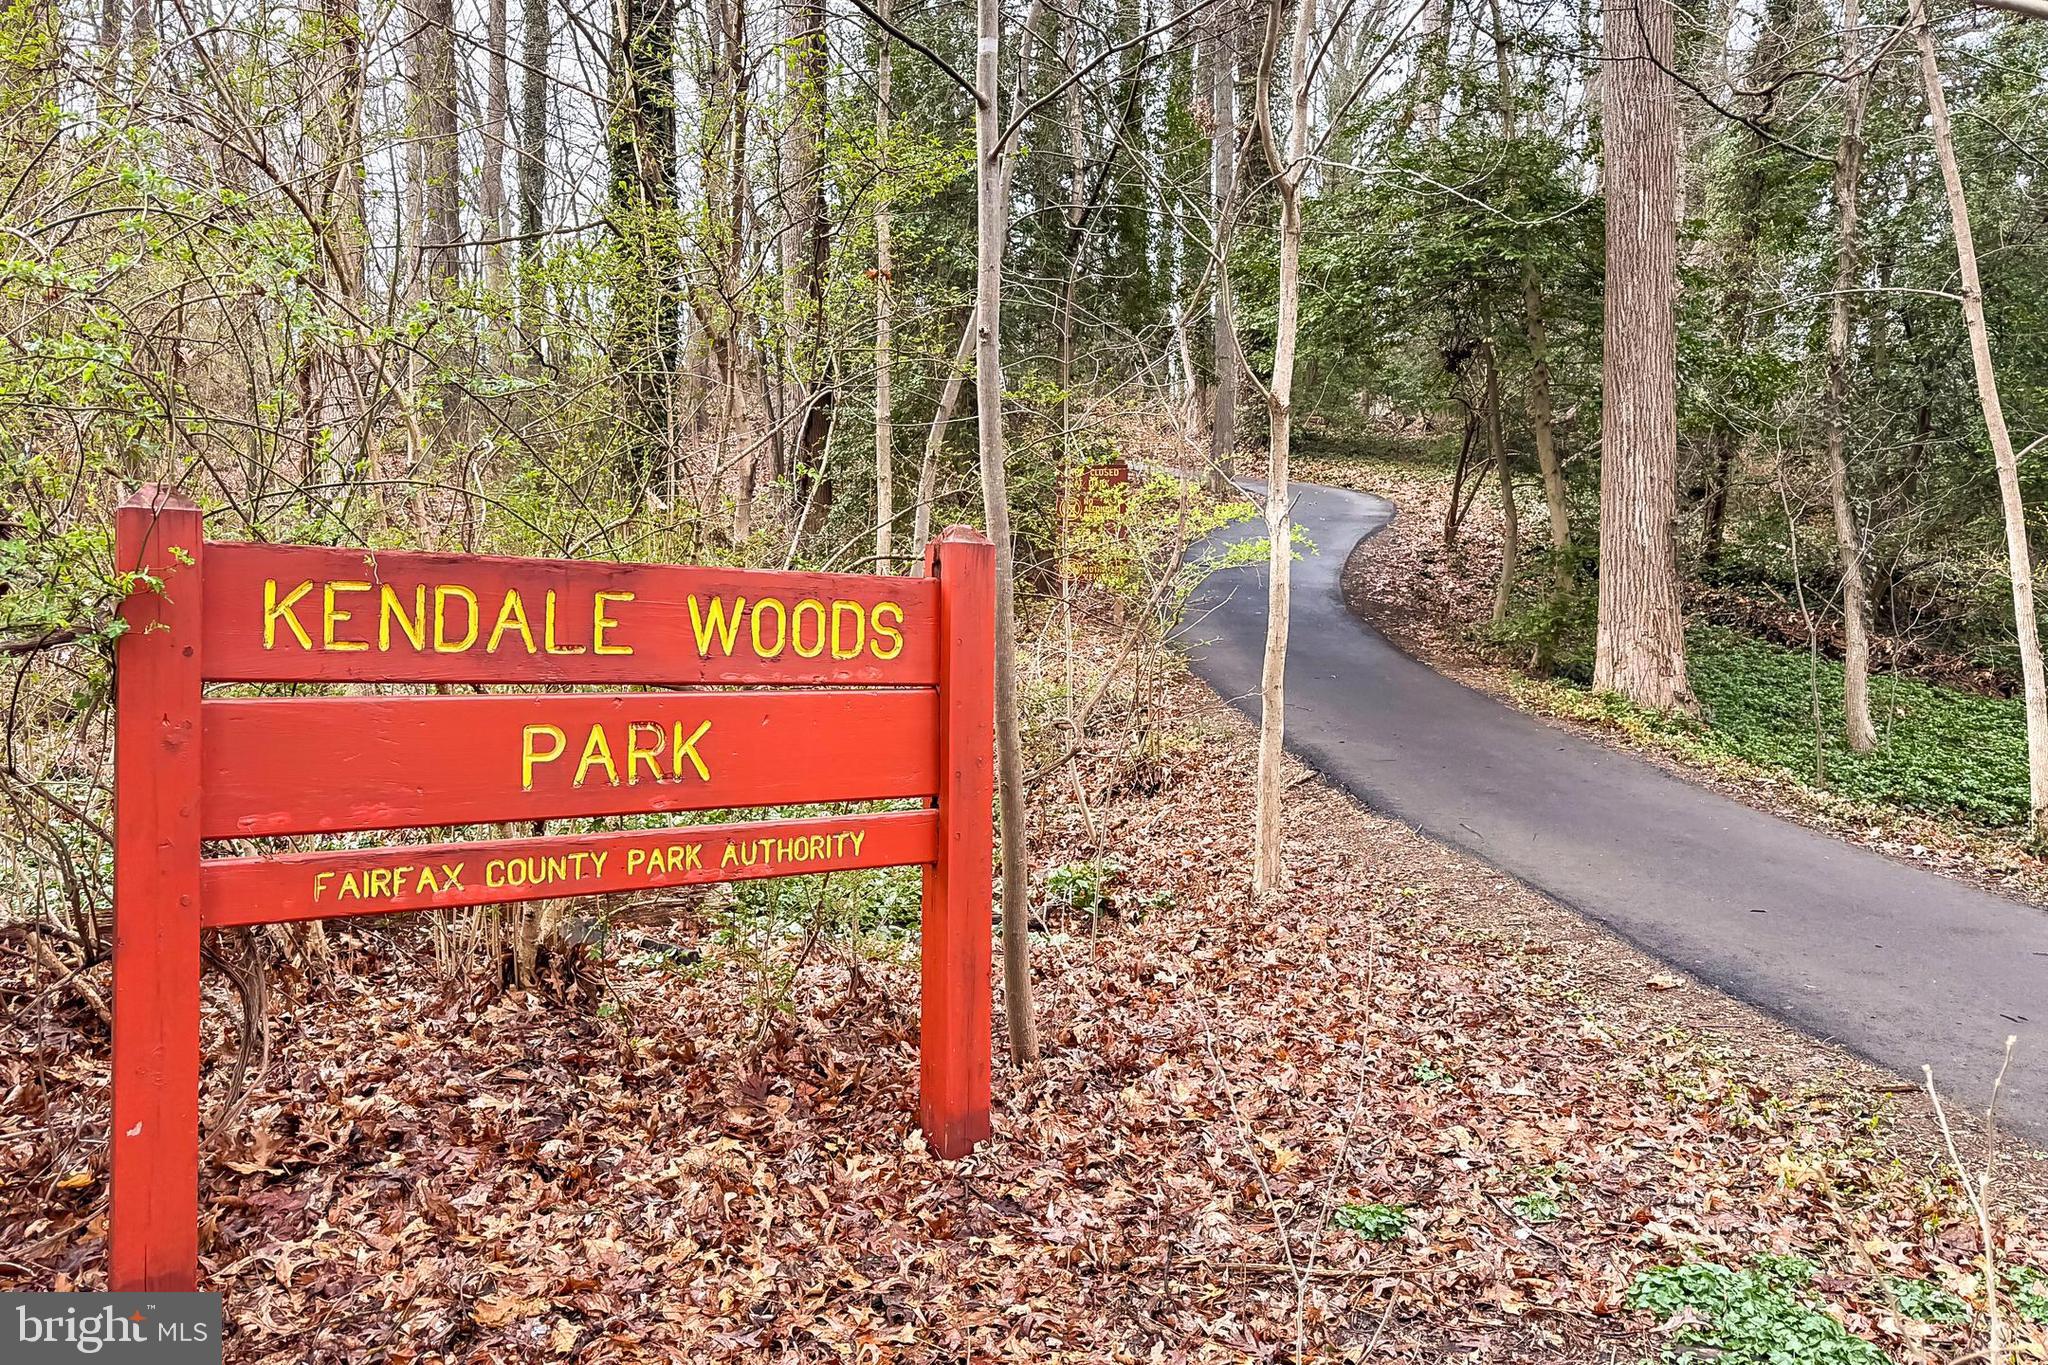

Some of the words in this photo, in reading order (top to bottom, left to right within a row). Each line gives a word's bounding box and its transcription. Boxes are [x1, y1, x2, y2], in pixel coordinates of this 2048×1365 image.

[1089, 468, 1120, 477] CLOSED
[263, 578, 636, 655] KENDALE
[687, 592, 904, 661] WOODS
[521, 718, 713, 791] PARK
[313, 861, 466, 903] FAIRFAX
[485, 850, 608, 889] COUNTY
[626, 843, 703, 876] PARK
[720, 829, 866, 869] AUTHORITY
